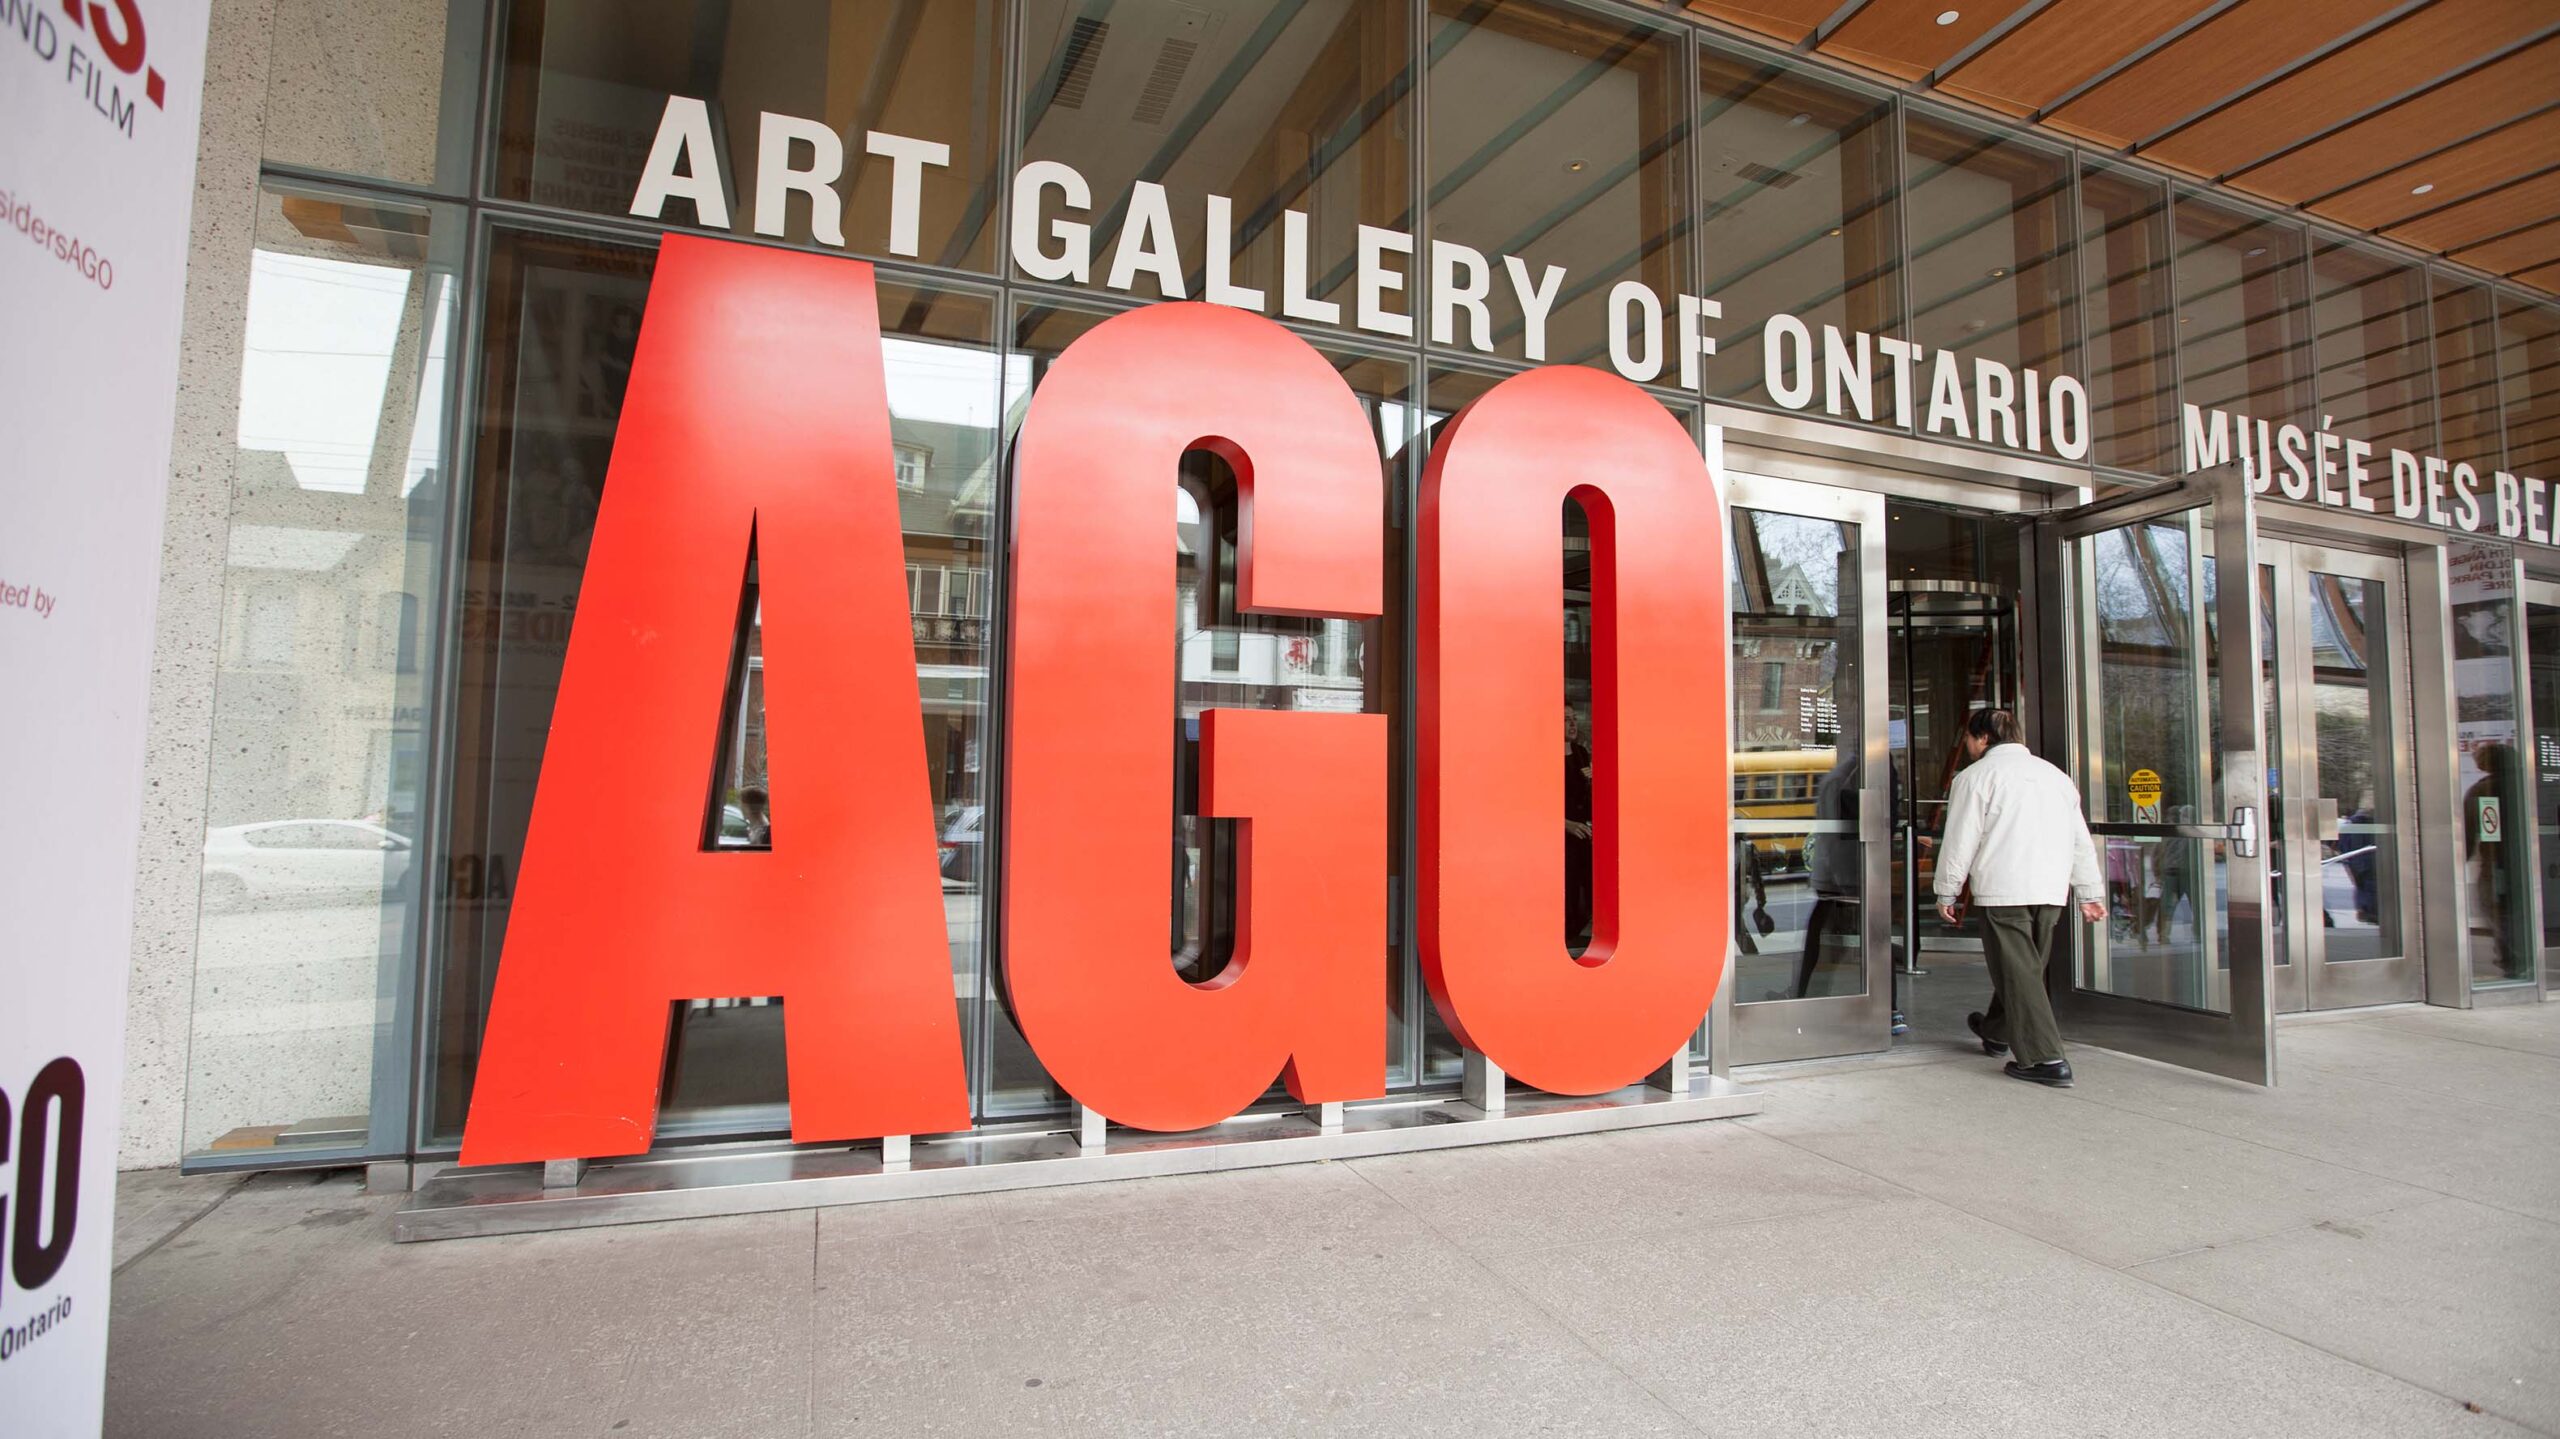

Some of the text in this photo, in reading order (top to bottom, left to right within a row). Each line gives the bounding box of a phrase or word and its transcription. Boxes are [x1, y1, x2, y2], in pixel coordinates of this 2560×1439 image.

[67, 43, 135, 139] FILM
[628, 94, 950, 258] ART
[1010, 160, 1567, 361] GALLERY
[1608, 280, 1722, 390] OF
[1763, 312, 2089, 461] ONTARIO
[2183, 403, 2376, 513] MUSÉE
[2391, 448, 2481, 533] DES
[34, 586, 56, 619] by
[460, 232, 1729, 1166] AGO
[2130, 784, 2160, 792] CAUTION
[0, 1295, 72, 1361] Ontario
